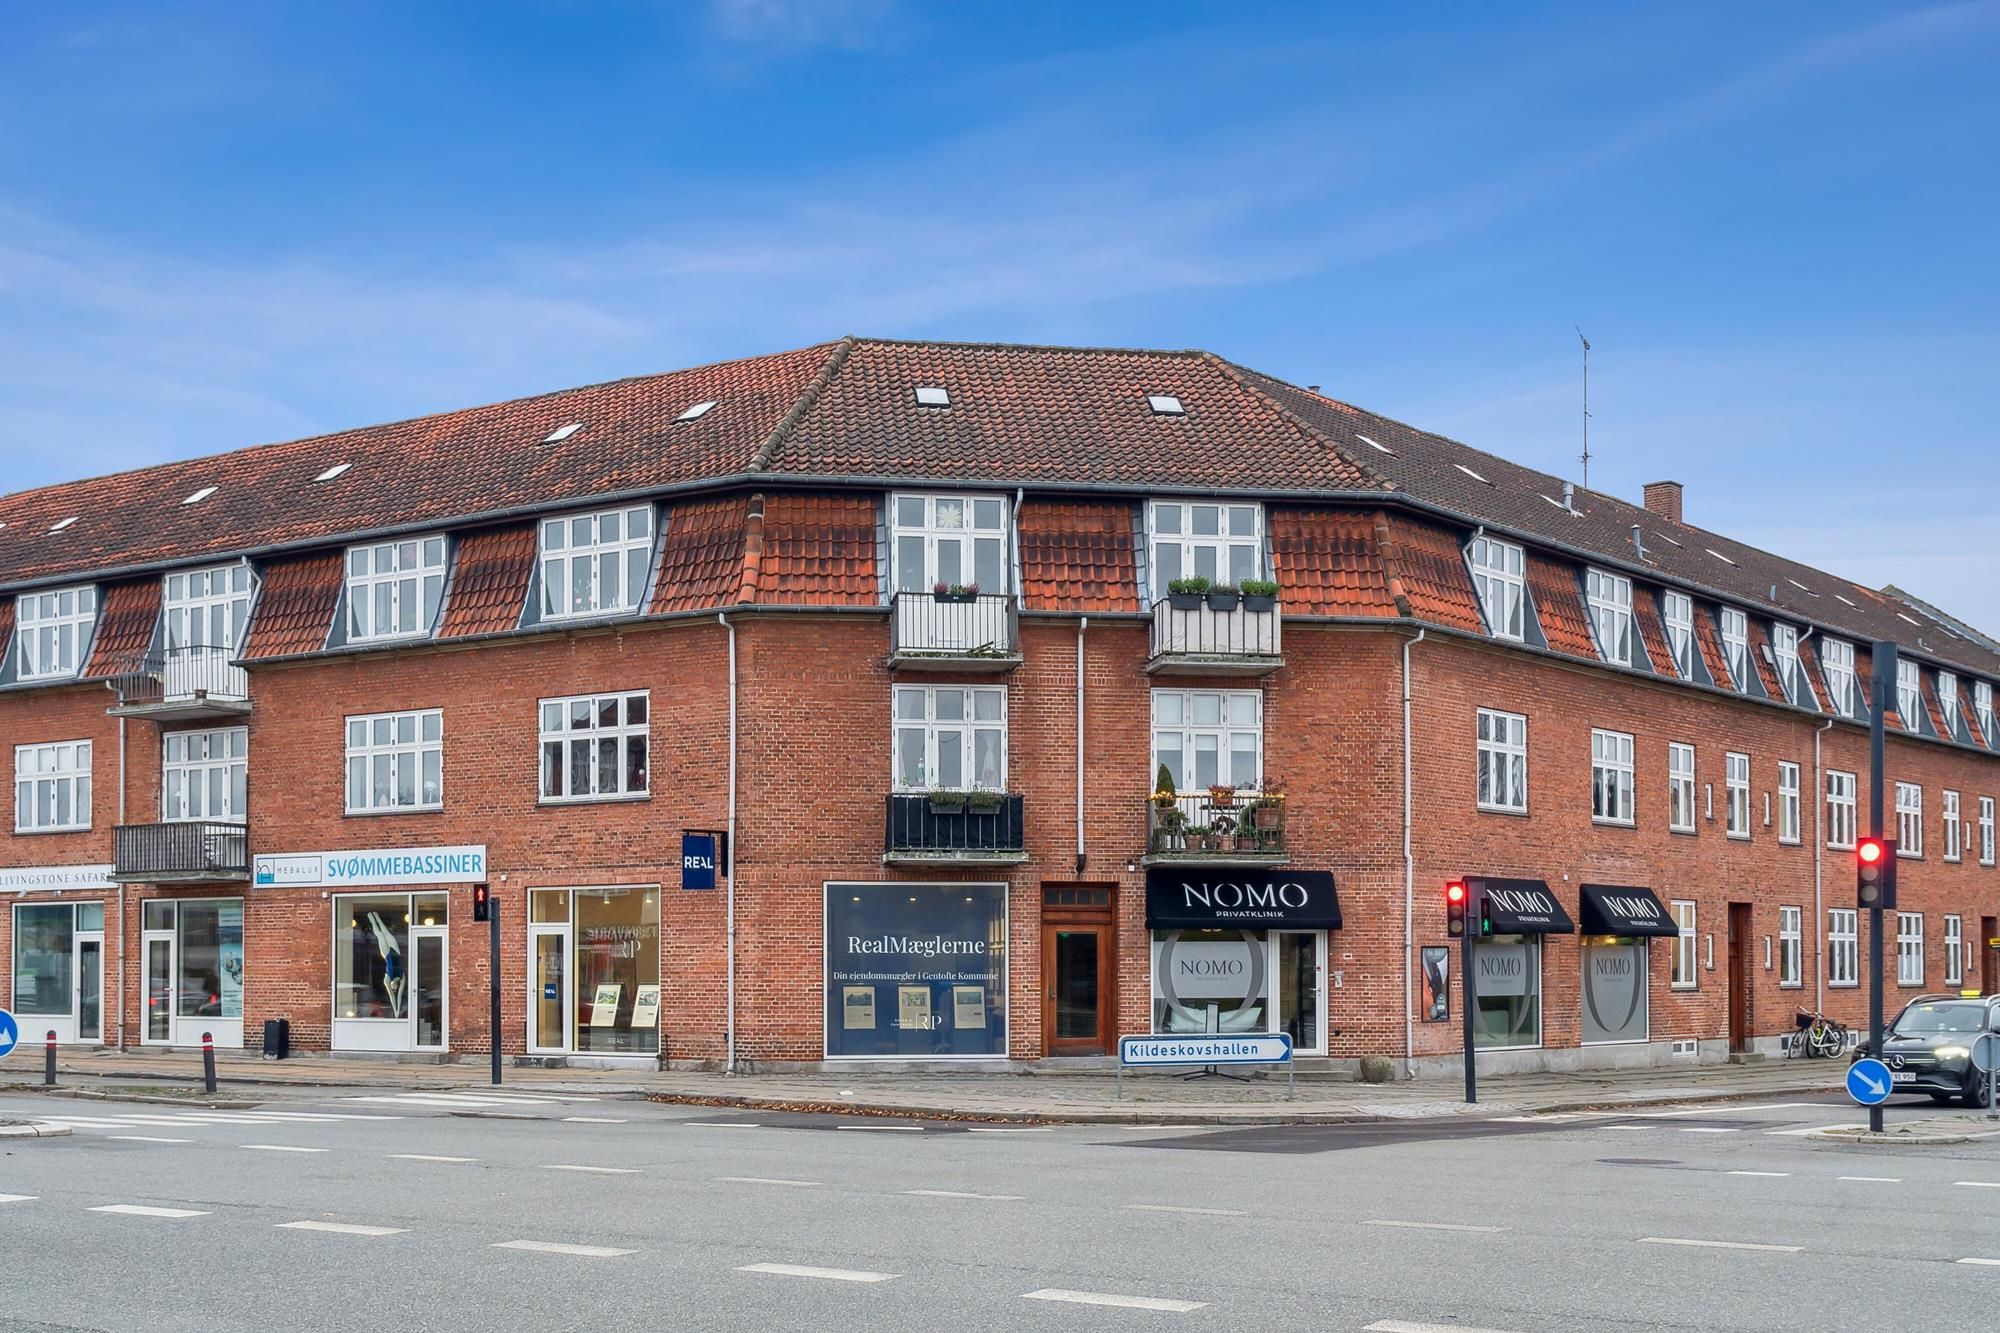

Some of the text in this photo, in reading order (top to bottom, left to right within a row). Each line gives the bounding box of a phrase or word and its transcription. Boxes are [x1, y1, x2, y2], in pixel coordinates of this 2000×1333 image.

[277, 866, 319, 875] MEBALUX
[328, 854, 482, 879] SVØMMEBASSINER
[684, 856, 714, 869] REAL
[0, 874, 71, 885] LIVINGSTONE
[1182, 883, 1308, 907] NOMO
[1486, 889, 1553, 913] NOMO
[1602, 895, 1660, 918] NOMO
[848, 936, 985, 957] RealMæglerne
[1181, 960, 1243, 975] NOMO
[1481, 957, 1521, 976] NOMO
[1596, 958, 1630, 976] NOMO
[833, 971, 848, 980] Din
[849, 971, 917, 981] ejendomsmægler
[922, 971, 956, 980] Gentofte
[958, 971, 998, 980] Kommune
[1130, 1044, 1258, 1056] Kildeskovshallen
